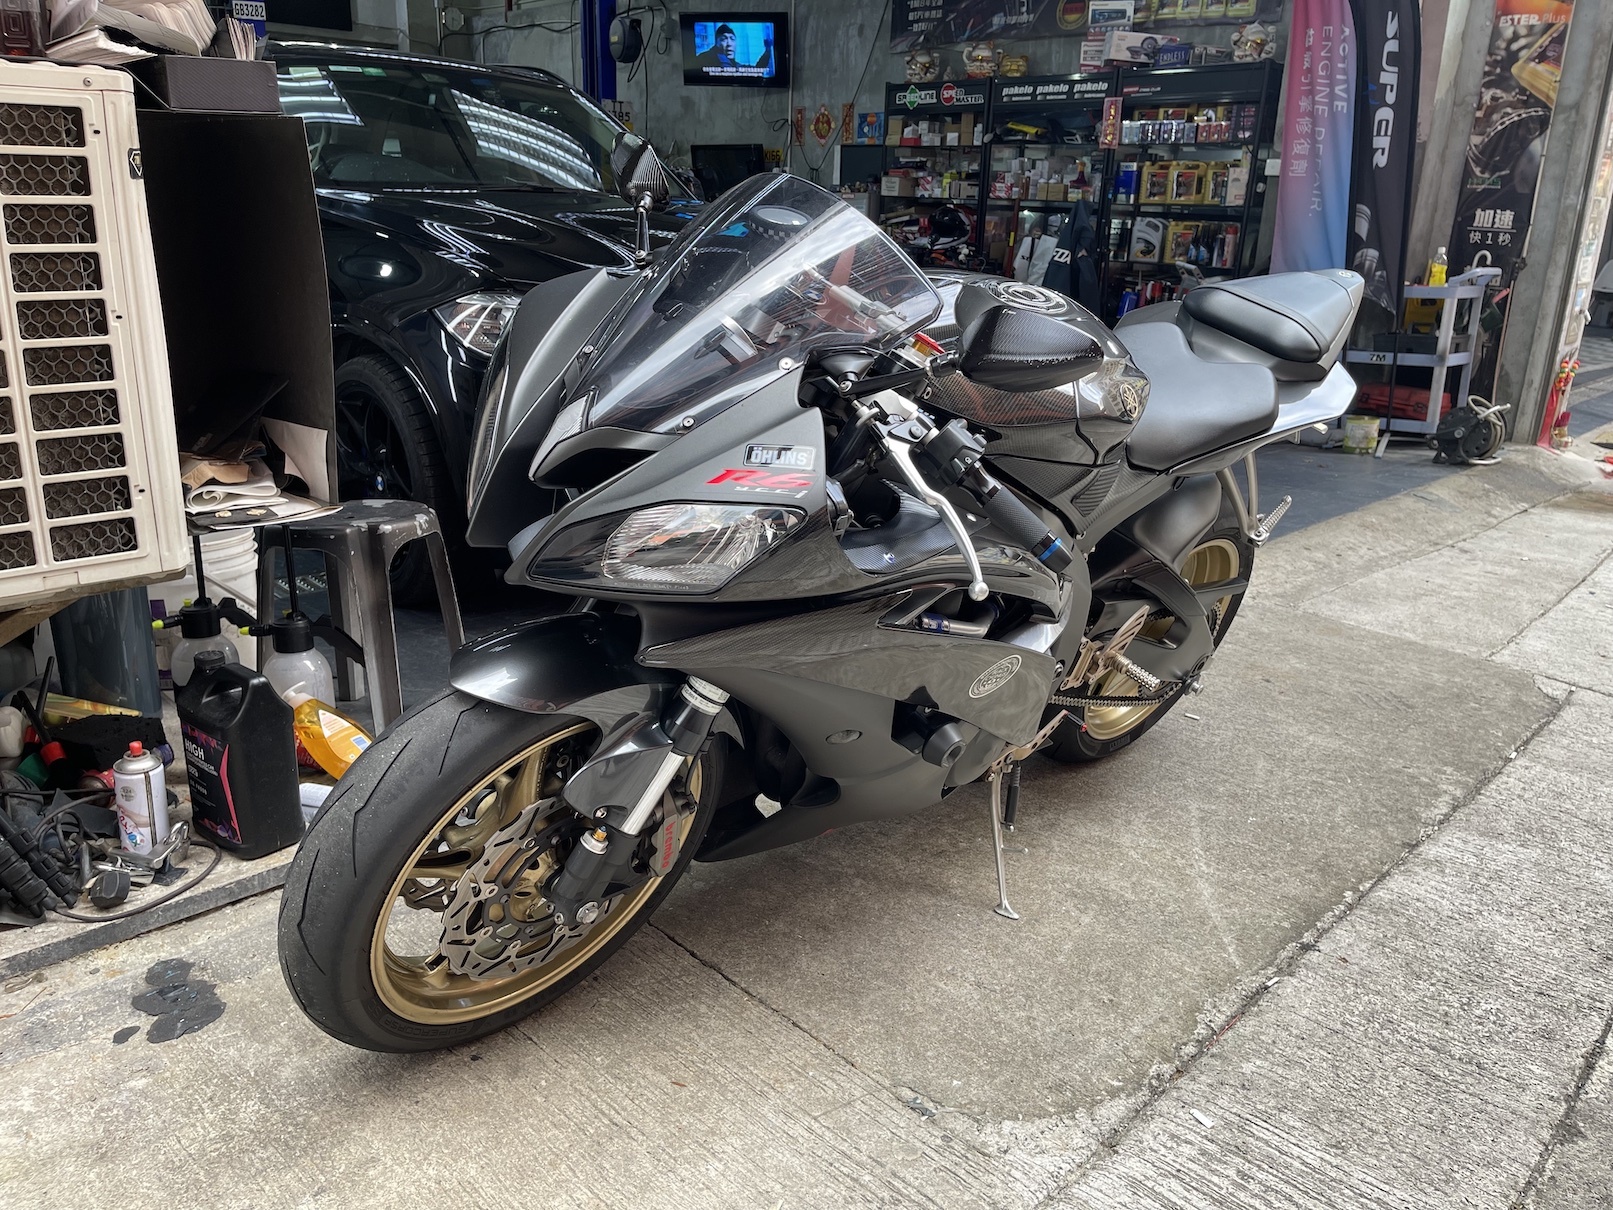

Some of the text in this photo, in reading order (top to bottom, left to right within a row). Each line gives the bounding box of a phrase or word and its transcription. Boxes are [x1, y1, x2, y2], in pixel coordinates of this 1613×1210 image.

[234, 3, 265, 18] GB3282
[1542, 12, 1567, 23] Plus
[1160, 50, 1186, 62] ENDLESS
[1313, 25, 1333, 118] ENGINE
[1333, 24, 1350, 113] ACTIVE
[1372, 10, 1400, 170] SUPER
[1472, 208, 1515, 230] 加速
[1370, 353, 1386, 362] 7M
[751, 446, 808, 466] ÖHLINS
[705, 469, 816, 488] R6
[185, 738, 205, 761] HIGH
[661, 821, 676, 869] brembo
